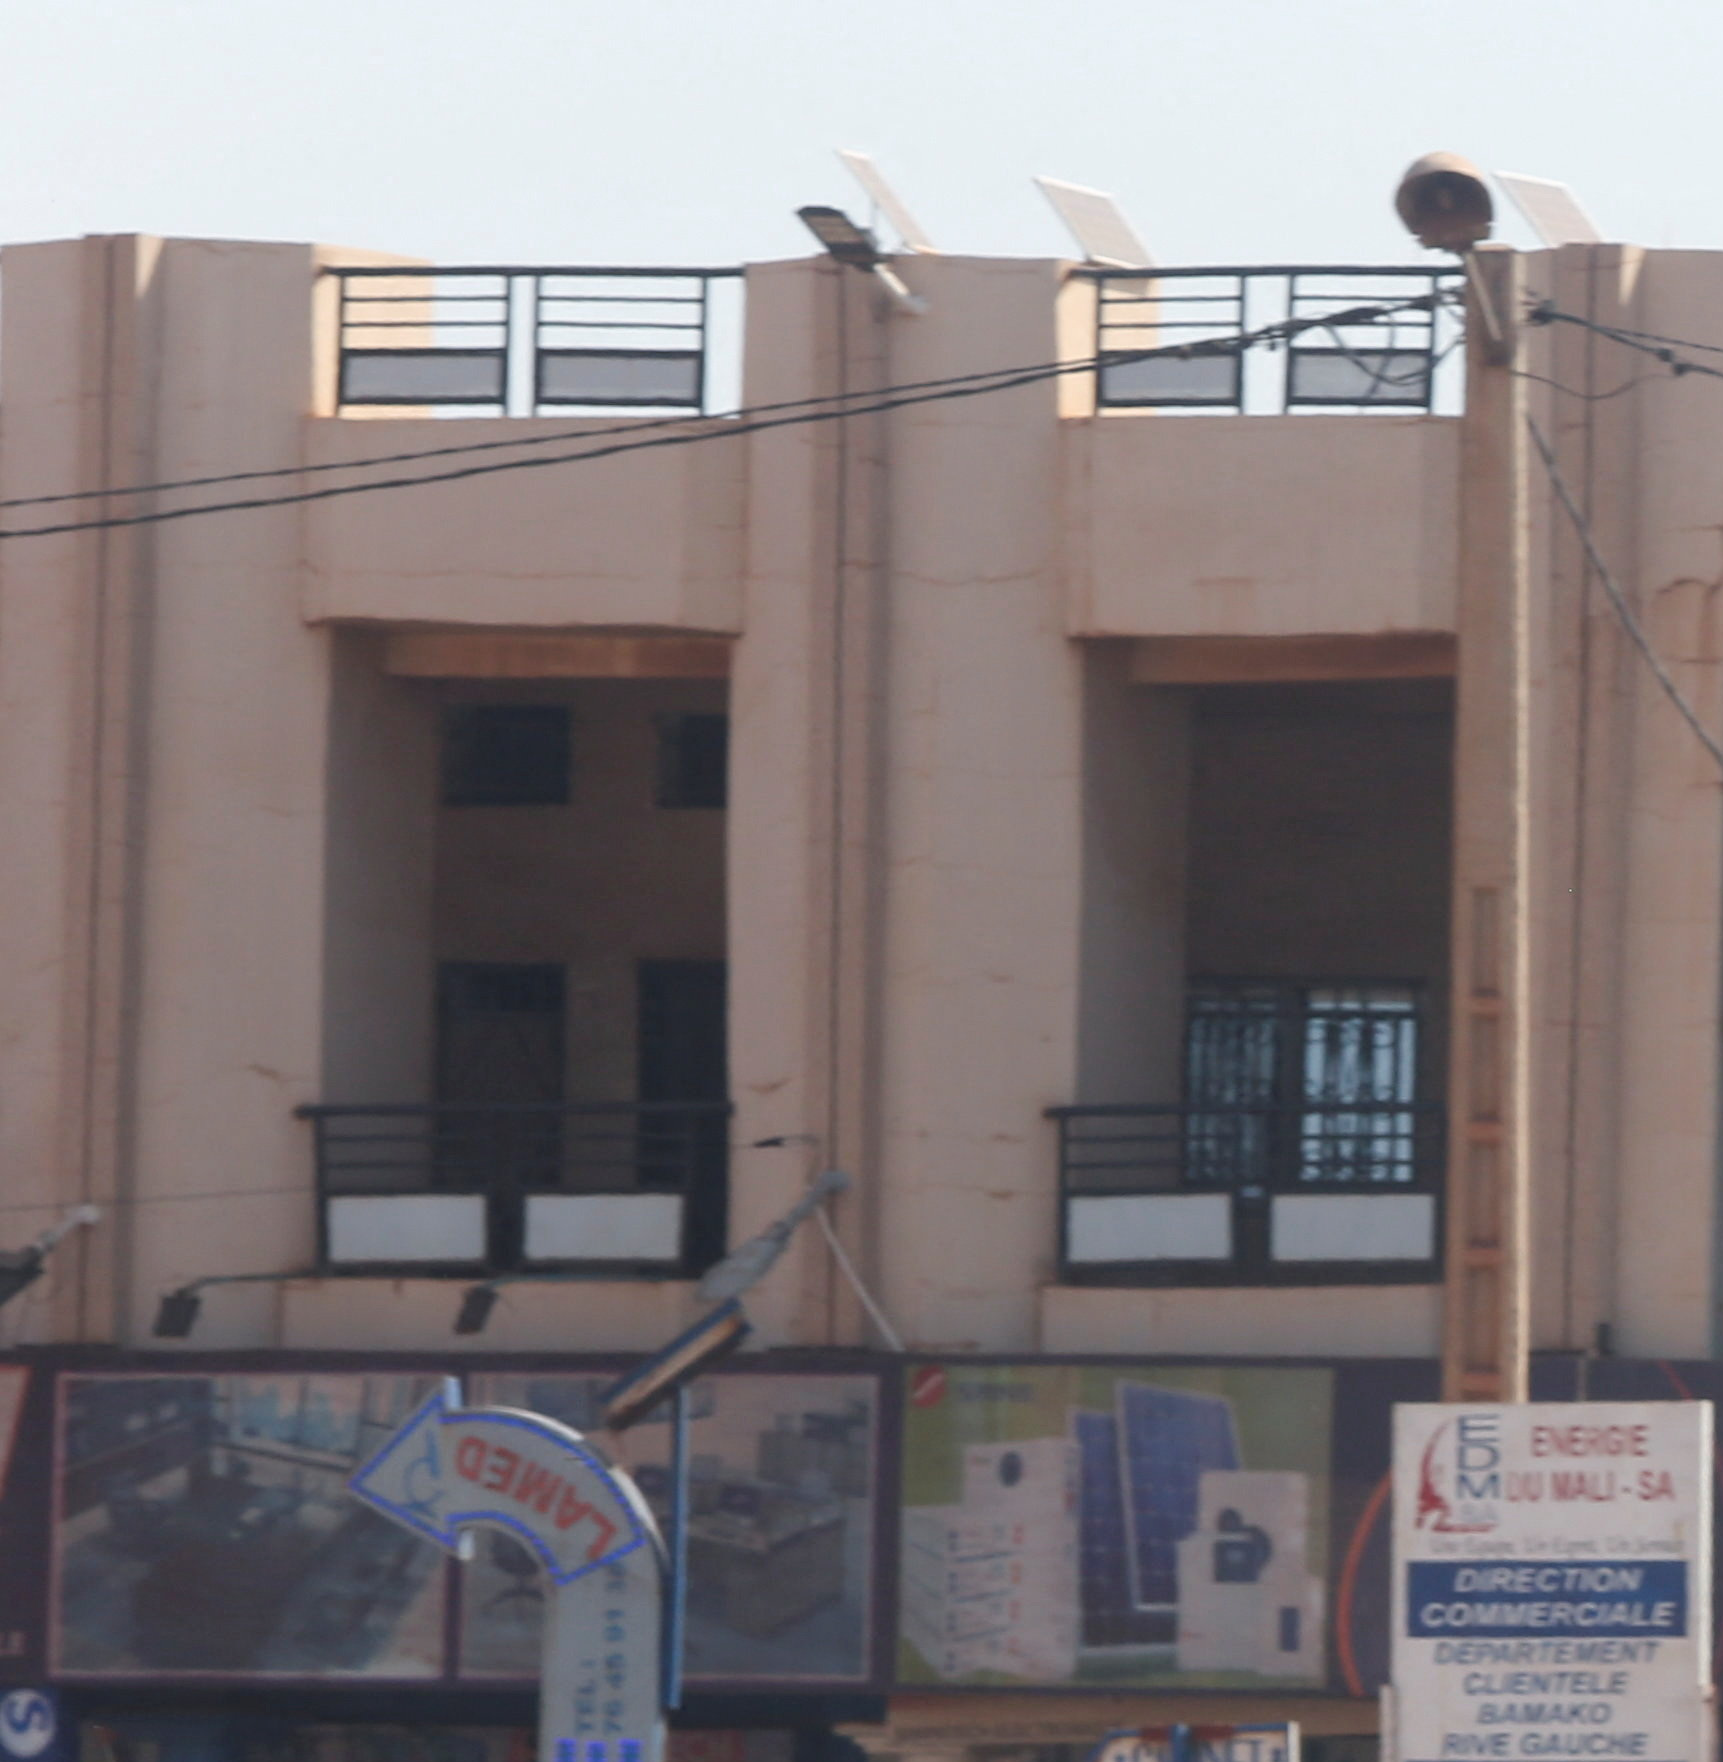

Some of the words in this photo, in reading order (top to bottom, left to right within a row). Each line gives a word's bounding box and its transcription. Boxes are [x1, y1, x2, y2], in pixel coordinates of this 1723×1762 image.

[1530, 1424, 1650, 1457] ENERGIE
[1507, 1471, 1543, 1502] DU
[1551, 1470, 1614, 1502] MALI
[1638, 1470, 1675, 1502] SA
[1453, 1567, 1644, 1593] DIRECTION
[1420, 1602, 1676, 1628] COMMERCIALE
[1433, 1641, 1661, 1665] DEPARTEMENT
[1462, 1671, 1630, 1696] CLIENTELE
[1476, 1703, 1614, 1726] BAMAKO
[1441, 1733, 1511, 1757] RIVE
[1519, 1732, 1649, 1757] GAUCHE
